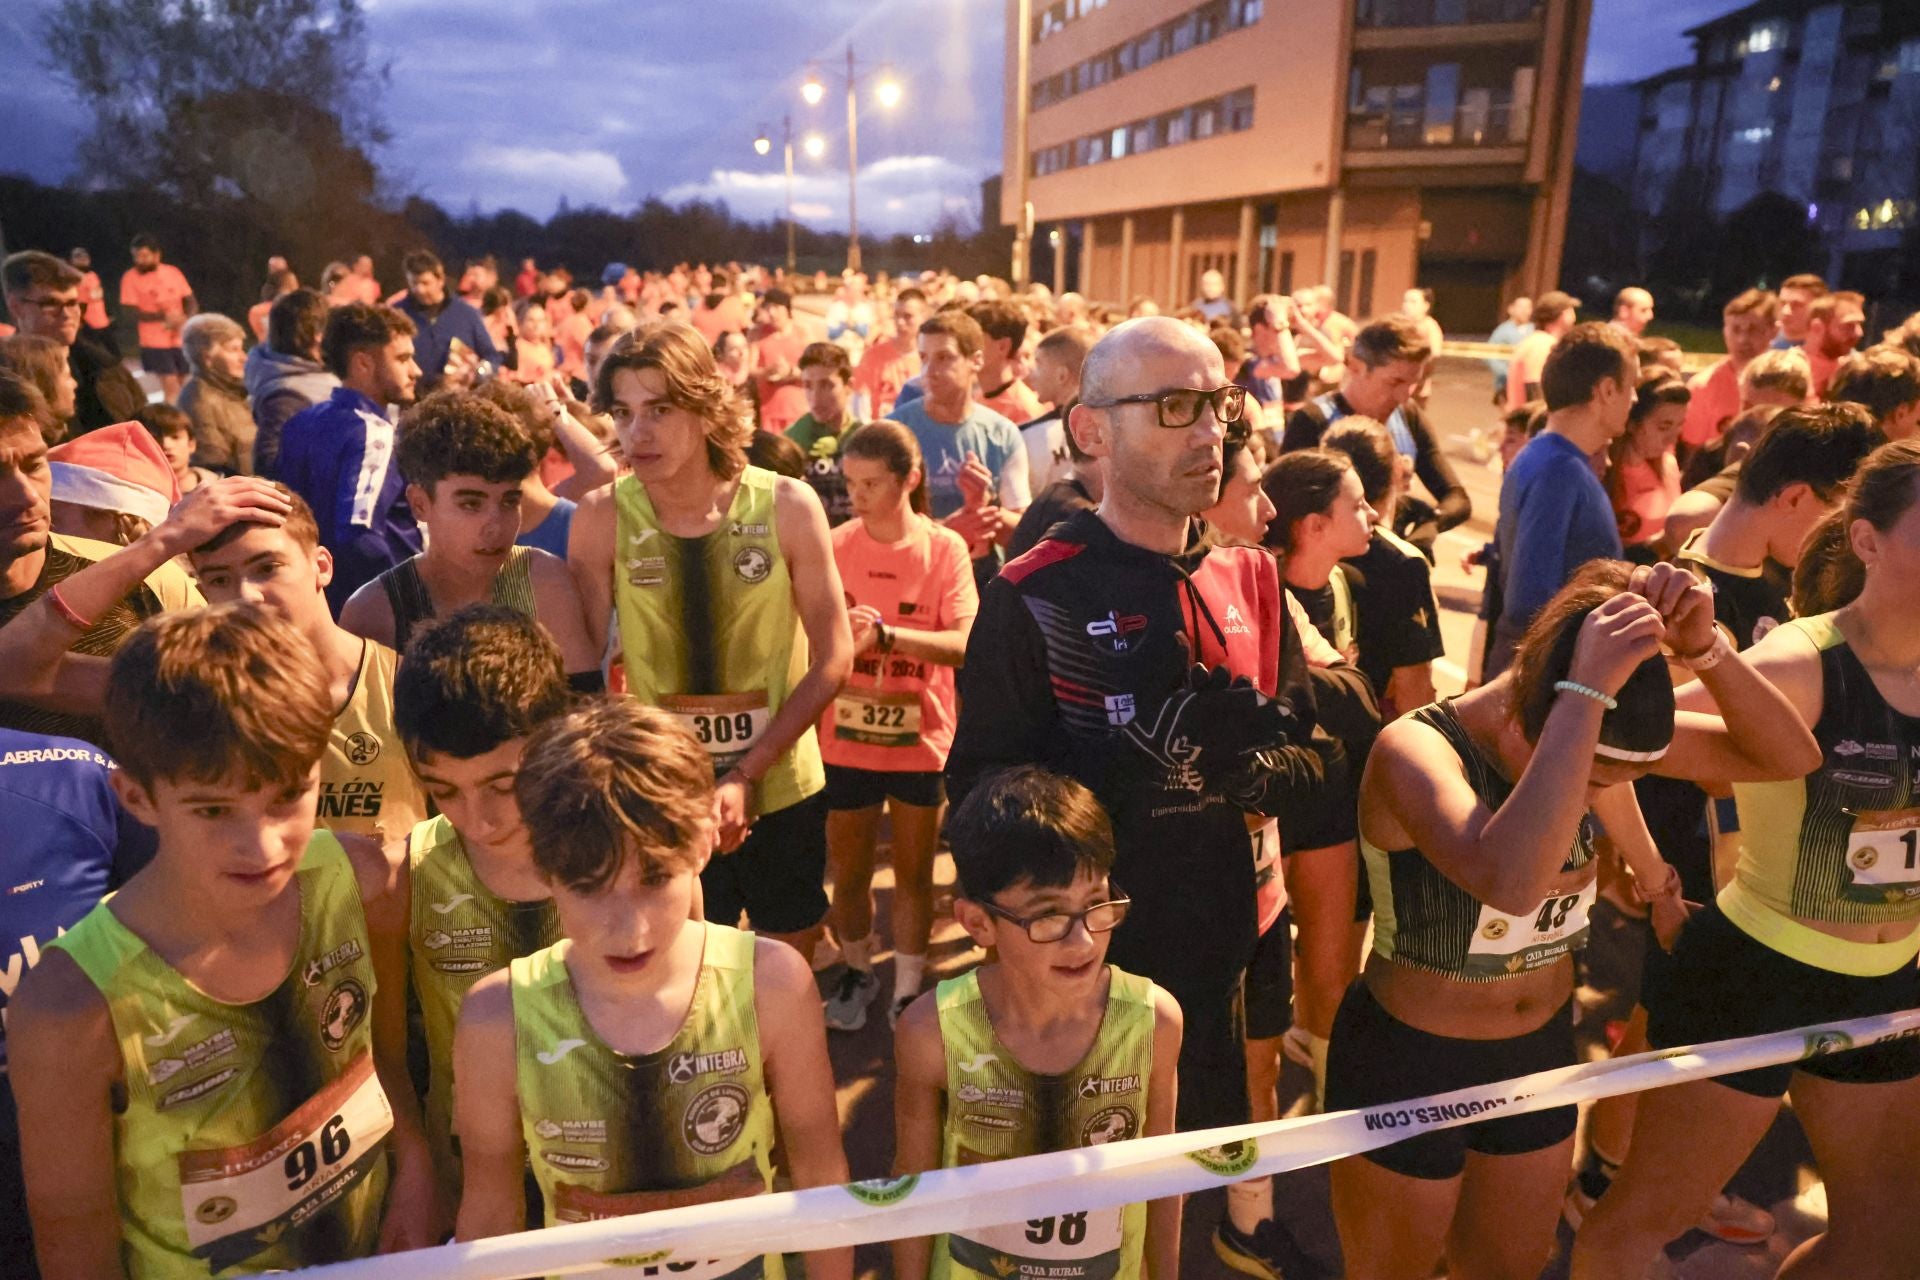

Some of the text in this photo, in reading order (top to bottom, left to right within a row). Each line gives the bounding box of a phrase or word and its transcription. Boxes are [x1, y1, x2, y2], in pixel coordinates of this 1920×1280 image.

[891, 658, 925, 679] 2024
[862, 704, 906, 728] 322
[693, 712, 752, 744] 309
[94, 753, 106, 766] &
[452, 928, 492, 936] MAYBE
[696, 1048, 746, 1074] INTEGRA
[986, 1088, 1024, 1096] MAYBE
[1100, 1075, 1140, 1093] INTEGRA
[562, 1120, 606, 1128] MAYBE
[284, 1114, 351, 1192] 96
[1024, 1210, 1088, 1246] 98
[1020, 1264, 1085, 1276] CAJA RURAL
